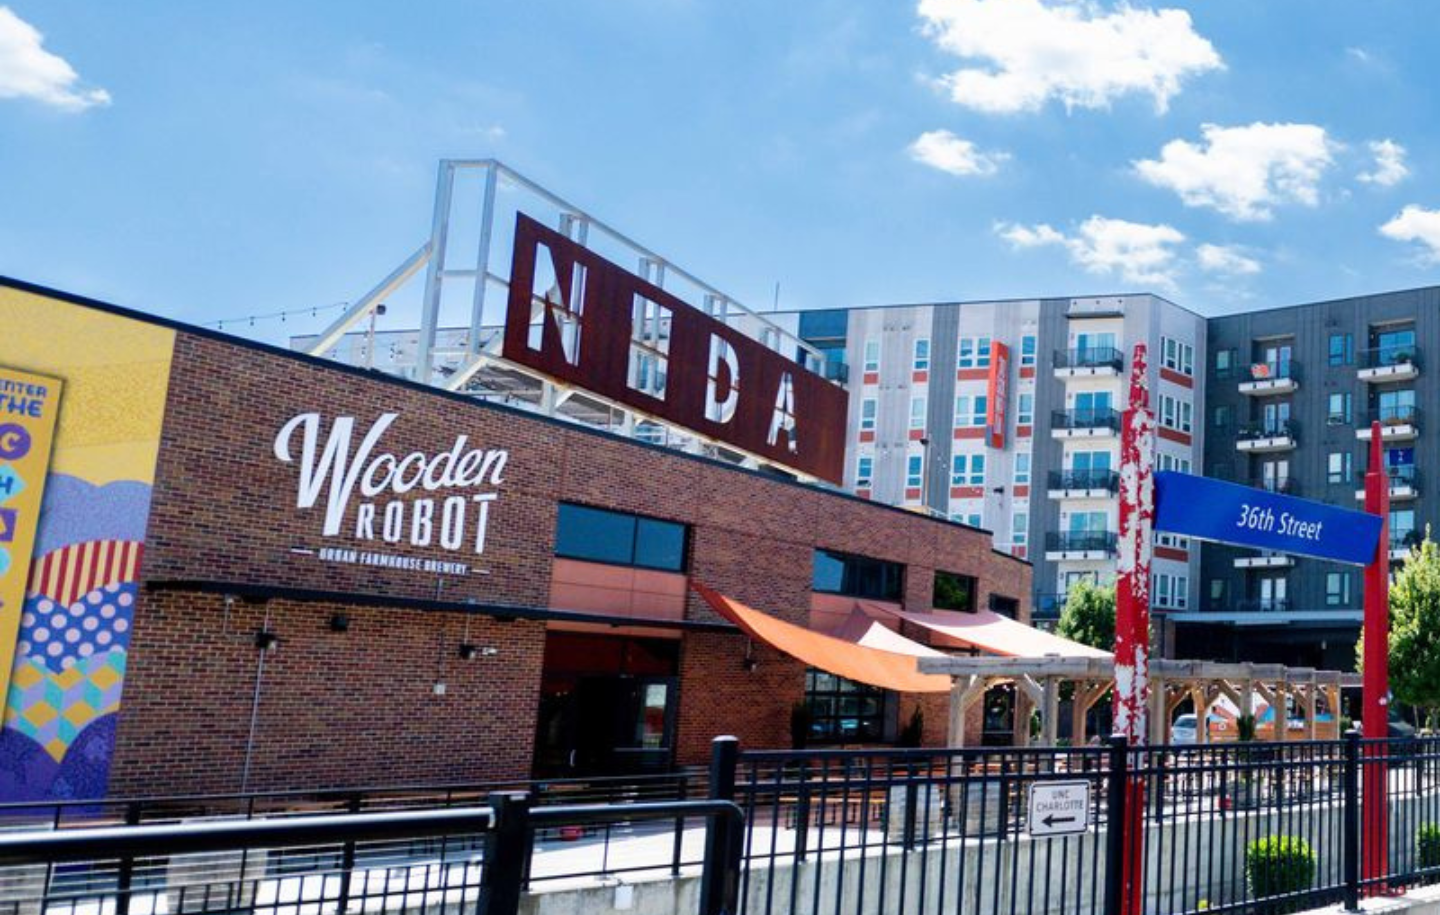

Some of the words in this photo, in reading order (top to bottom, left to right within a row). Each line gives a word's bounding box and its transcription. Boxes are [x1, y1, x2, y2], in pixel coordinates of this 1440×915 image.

[526, 241, 799, 453] NDA
[273, 412, 508, 536] Wooden
[355, 493, 498, 554] ROBOT
[1236, 504, 1275, 532] 36th
[1277, 512, 1322, 541] Street
[319, 548, 356, 563] URBAN
[361, 552, 421, 570] FARMHOUSE
[424, 560, 467, 575] BREWERY
[1036, 799, 1084, 813] CHARLOTTE
